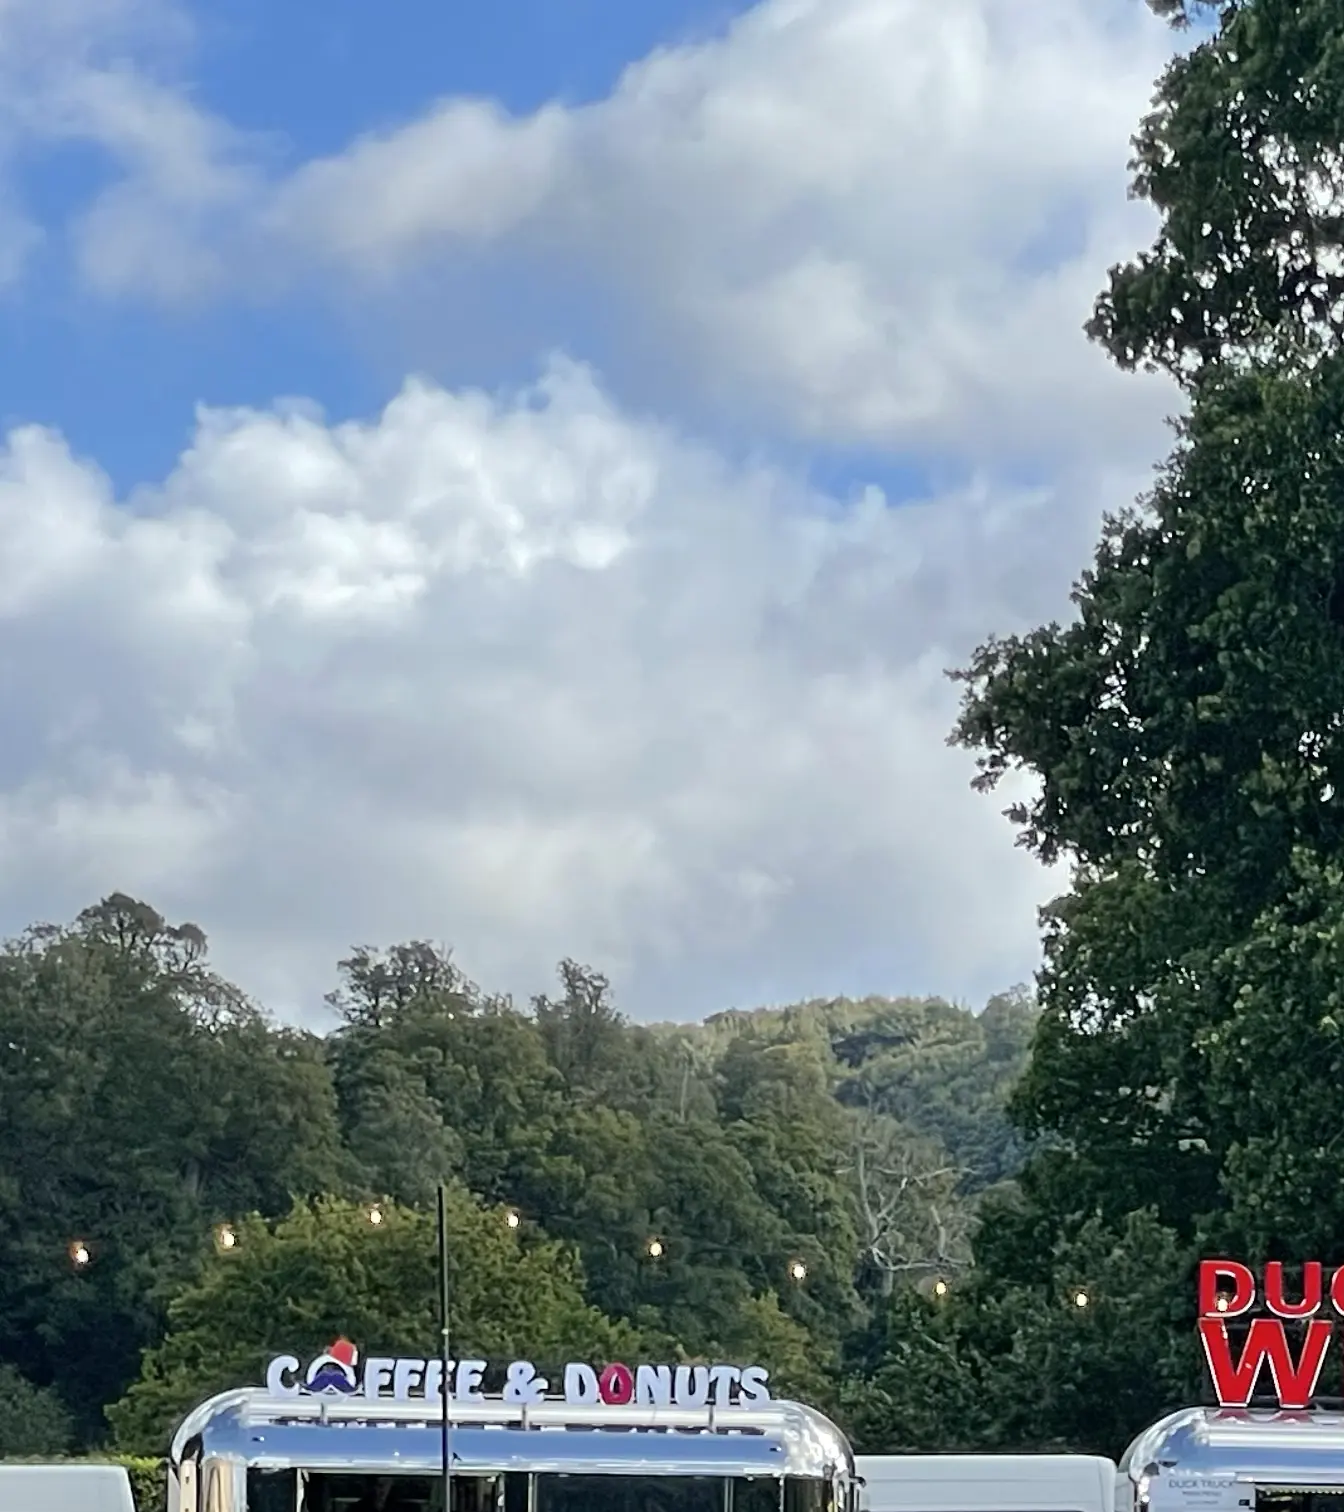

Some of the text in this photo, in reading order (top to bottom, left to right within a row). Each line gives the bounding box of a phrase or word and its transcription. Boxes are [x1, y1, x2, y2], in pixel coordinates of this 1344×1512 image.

[266, 1350, 771, 1408] COFFEE & DONUTS
